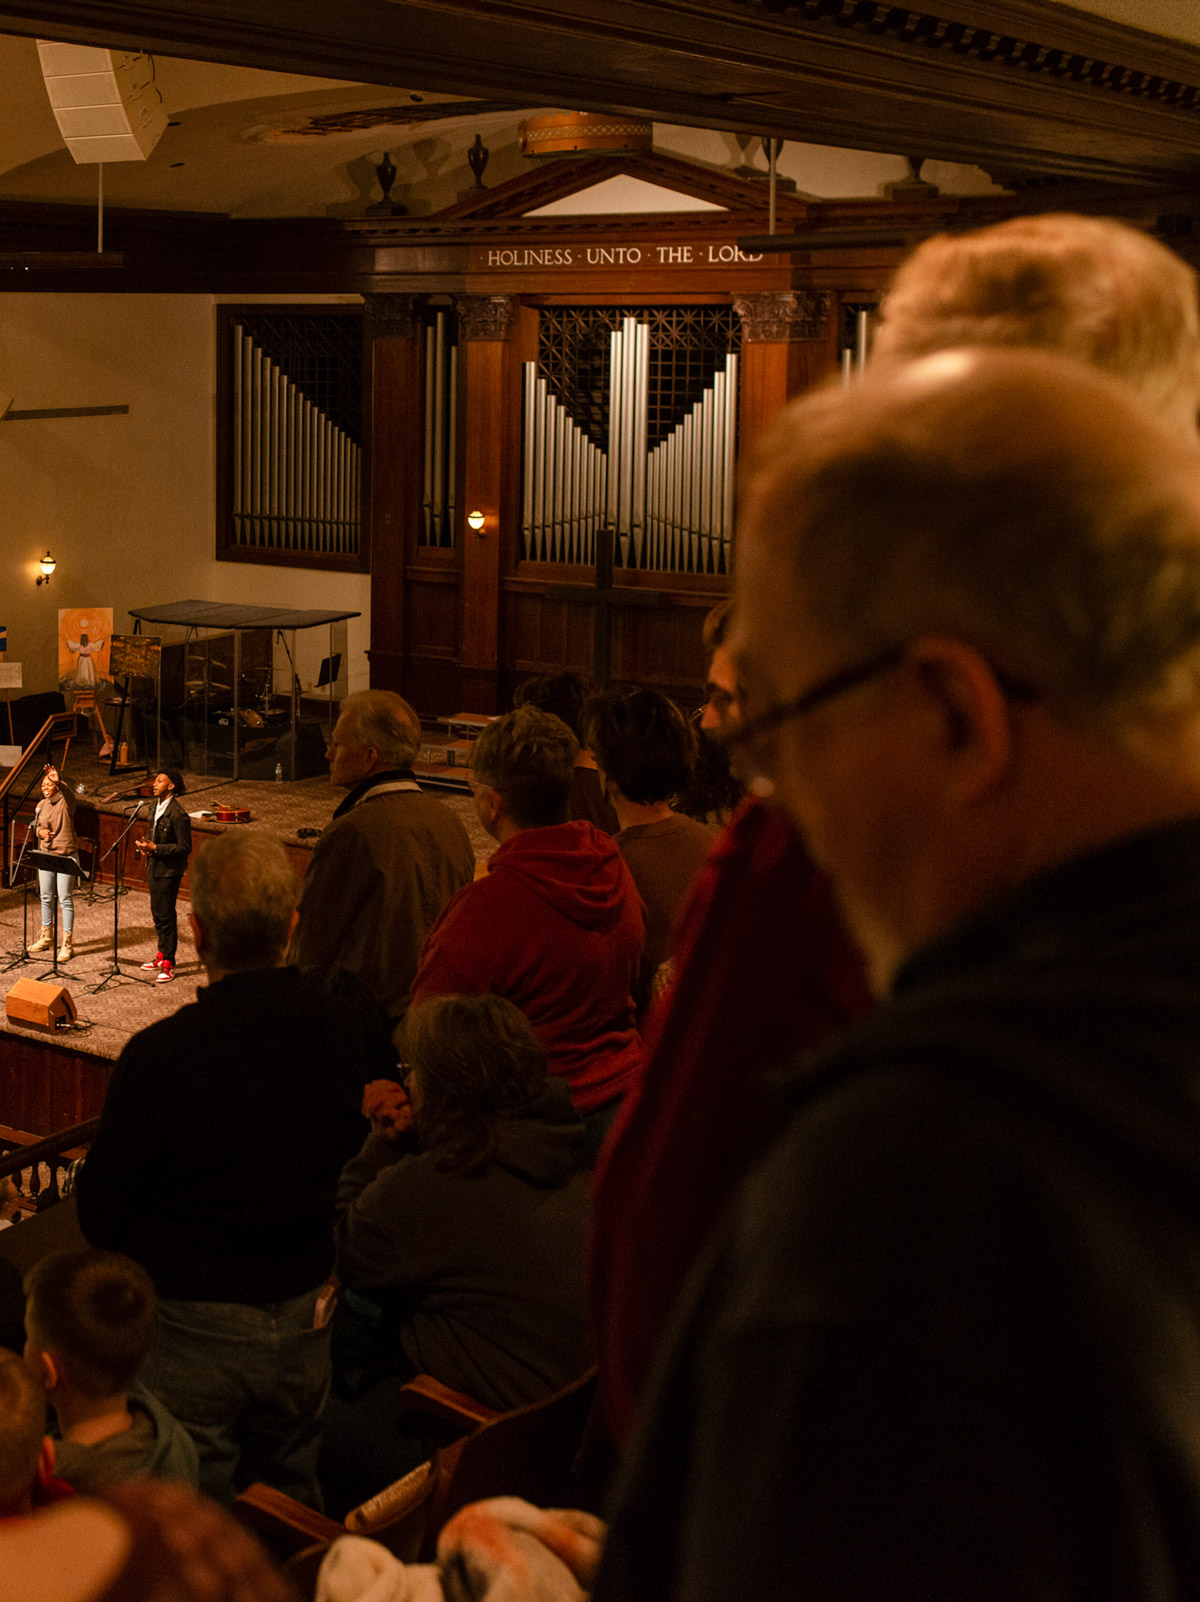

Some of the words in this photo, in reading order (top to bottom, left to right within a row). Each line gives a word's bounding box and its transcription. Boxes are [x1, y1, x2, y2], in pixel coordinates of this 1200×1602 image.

[487, 249, 573, 266] HOLINESS
[586, 247, 642, 265] UNTO
[657, 246, 694, 263] THE
